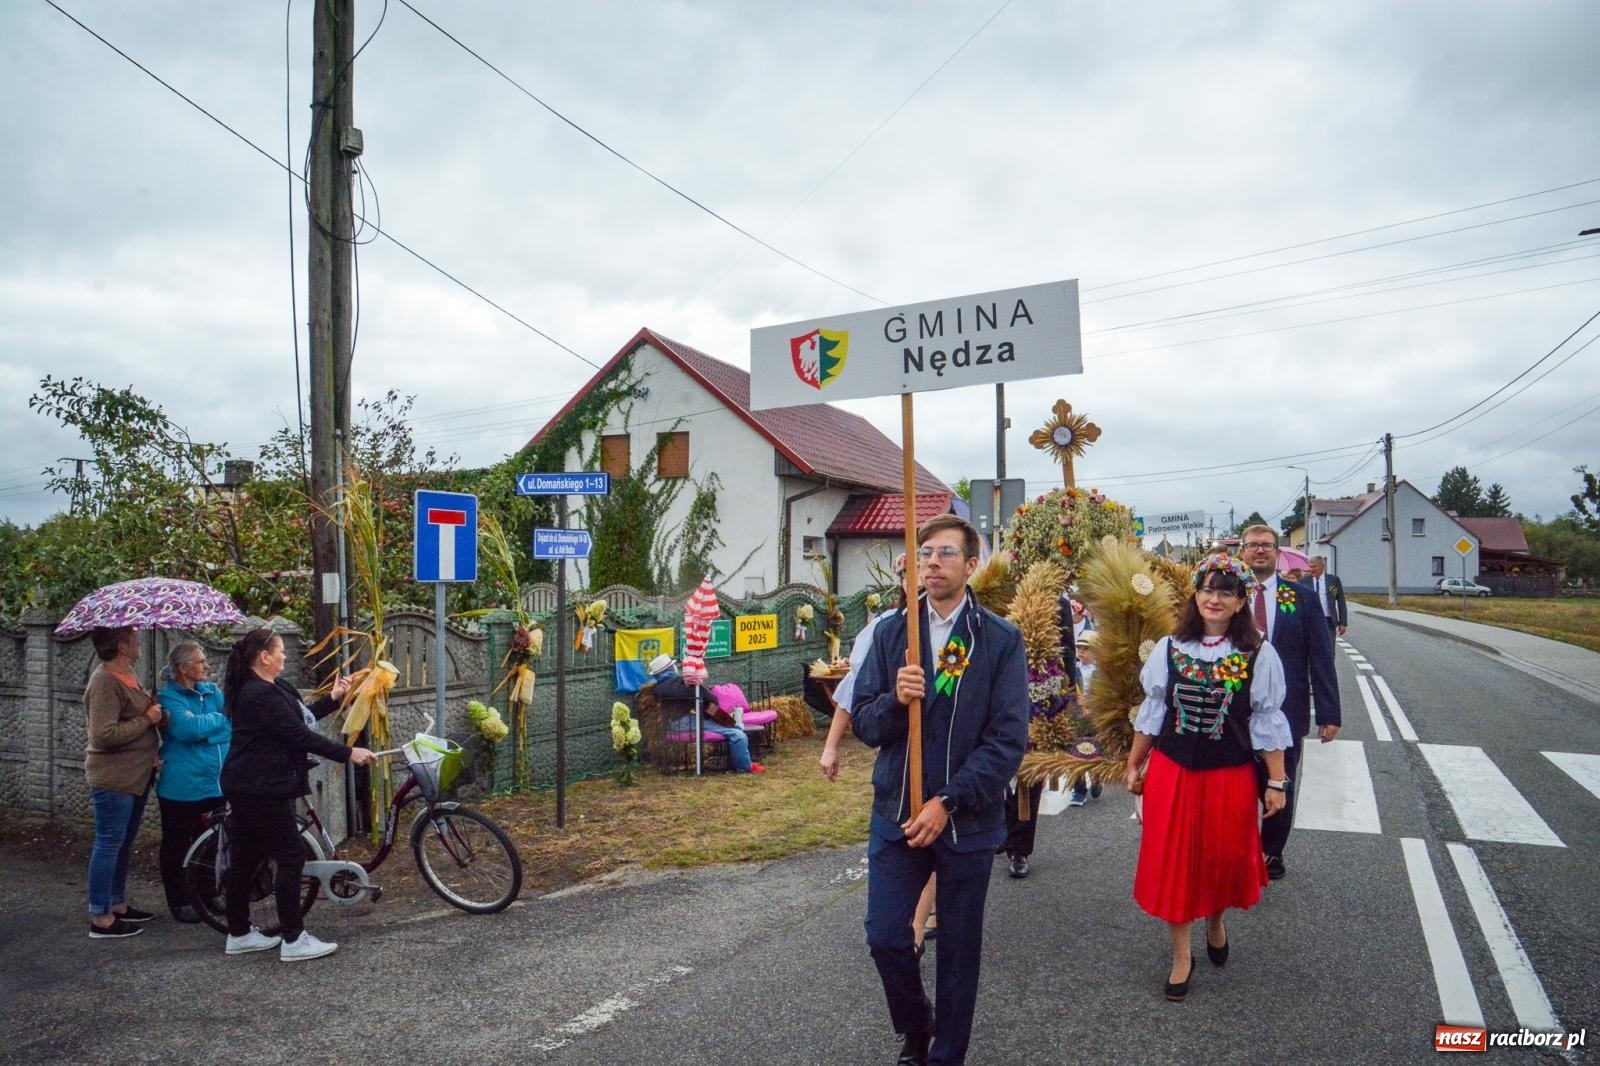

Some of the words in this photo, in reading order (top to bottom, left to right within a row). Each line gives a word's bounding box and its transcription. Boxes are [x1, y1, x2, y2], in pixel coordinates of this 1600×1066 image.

[884, 298, 1034, 343] GMINA
[903, 340, 1015, 376] Nędza
[1161, 514, 1190, 524] GMINA
[1148, 524, 1180, 534] Pietrowice
[1181, 521, 1204, 530] Wielkie
[740, 617, 774, 632] DOŻYNKI
[748, 634, 767, 645] 2025
